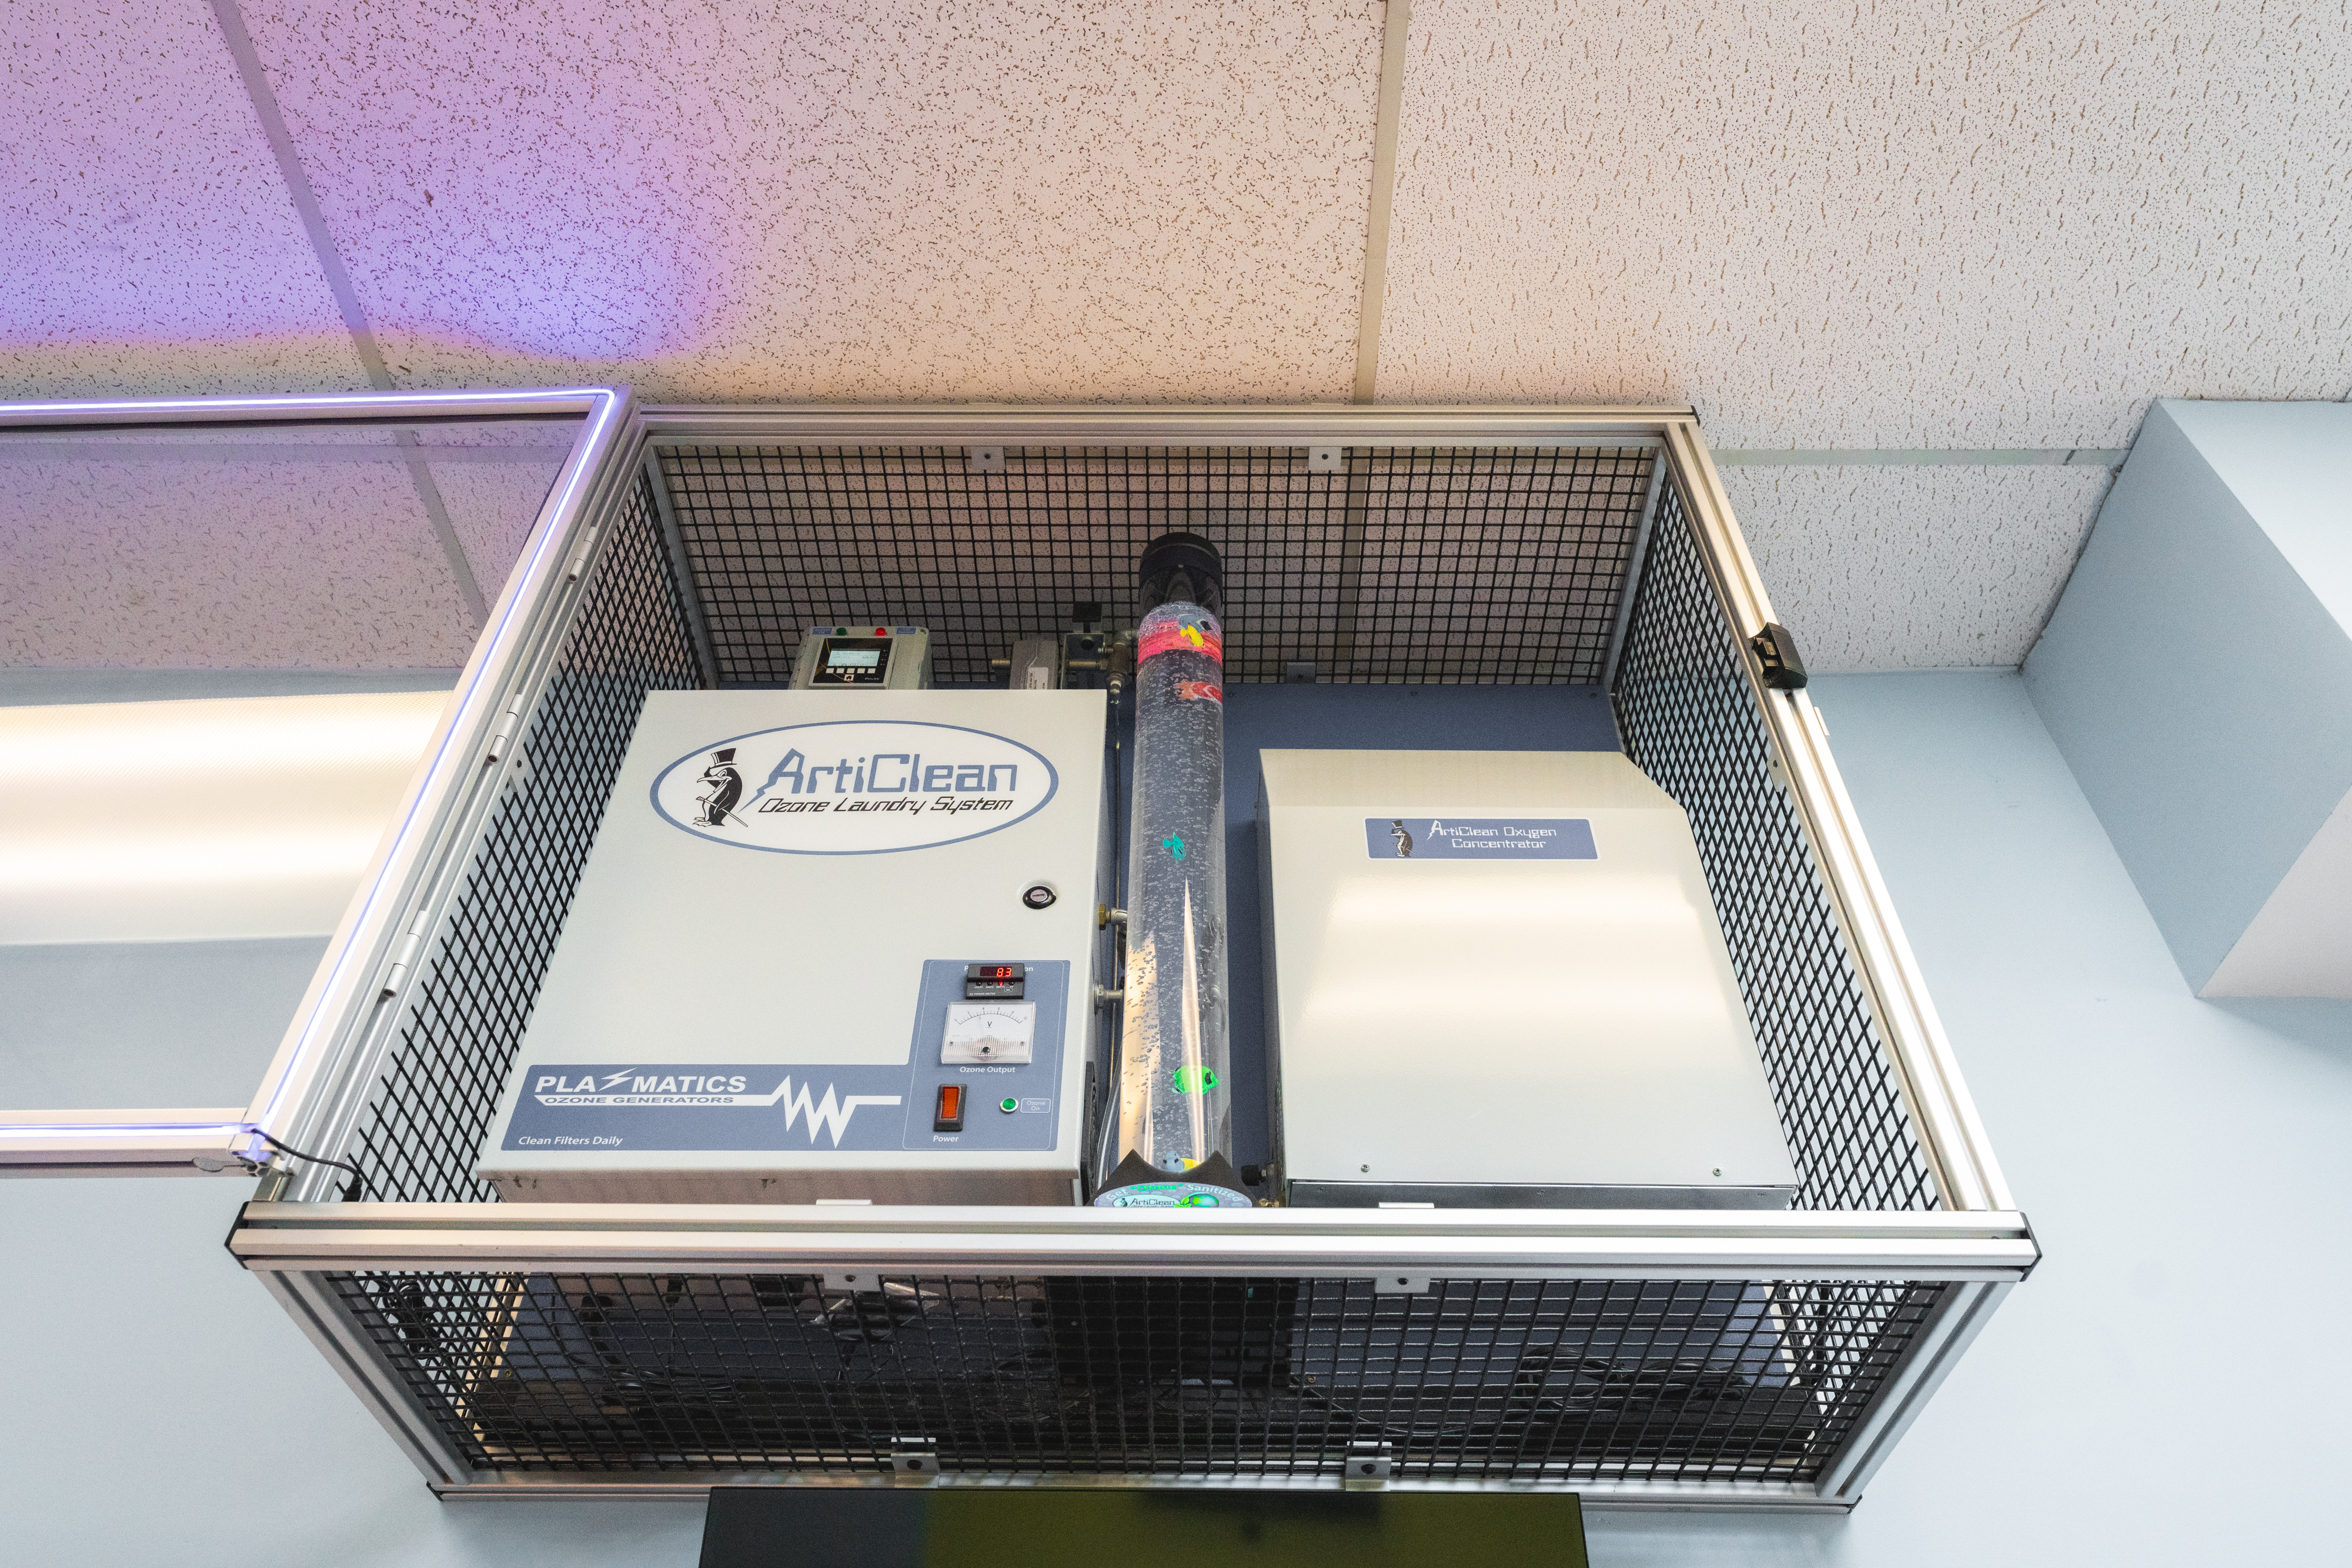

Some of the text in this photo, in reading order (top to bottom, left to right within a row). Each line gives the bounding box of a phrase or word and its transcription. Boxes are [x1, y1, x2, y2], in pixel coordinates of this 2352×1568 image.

[753, 748, 1017, 800] ArtiClean
[758, 796, 1014, 817] Ozone Laundry System
[1428, 820, 1557, 839] ArtiClean Oxygen
[1451, 838, 1546, 848] Concentrator
[996, 967, 1013, 977] 83
[987, 1066, 1016, 1074] Output
[518, 1135, 624, 1147] Clean Filters Daily
[1106, 1188, 1128, 1201] Get
[1187, 1183, 1244, 1202] Sanitized
[1130, 1198, 1175, 1206] ArtiClean
